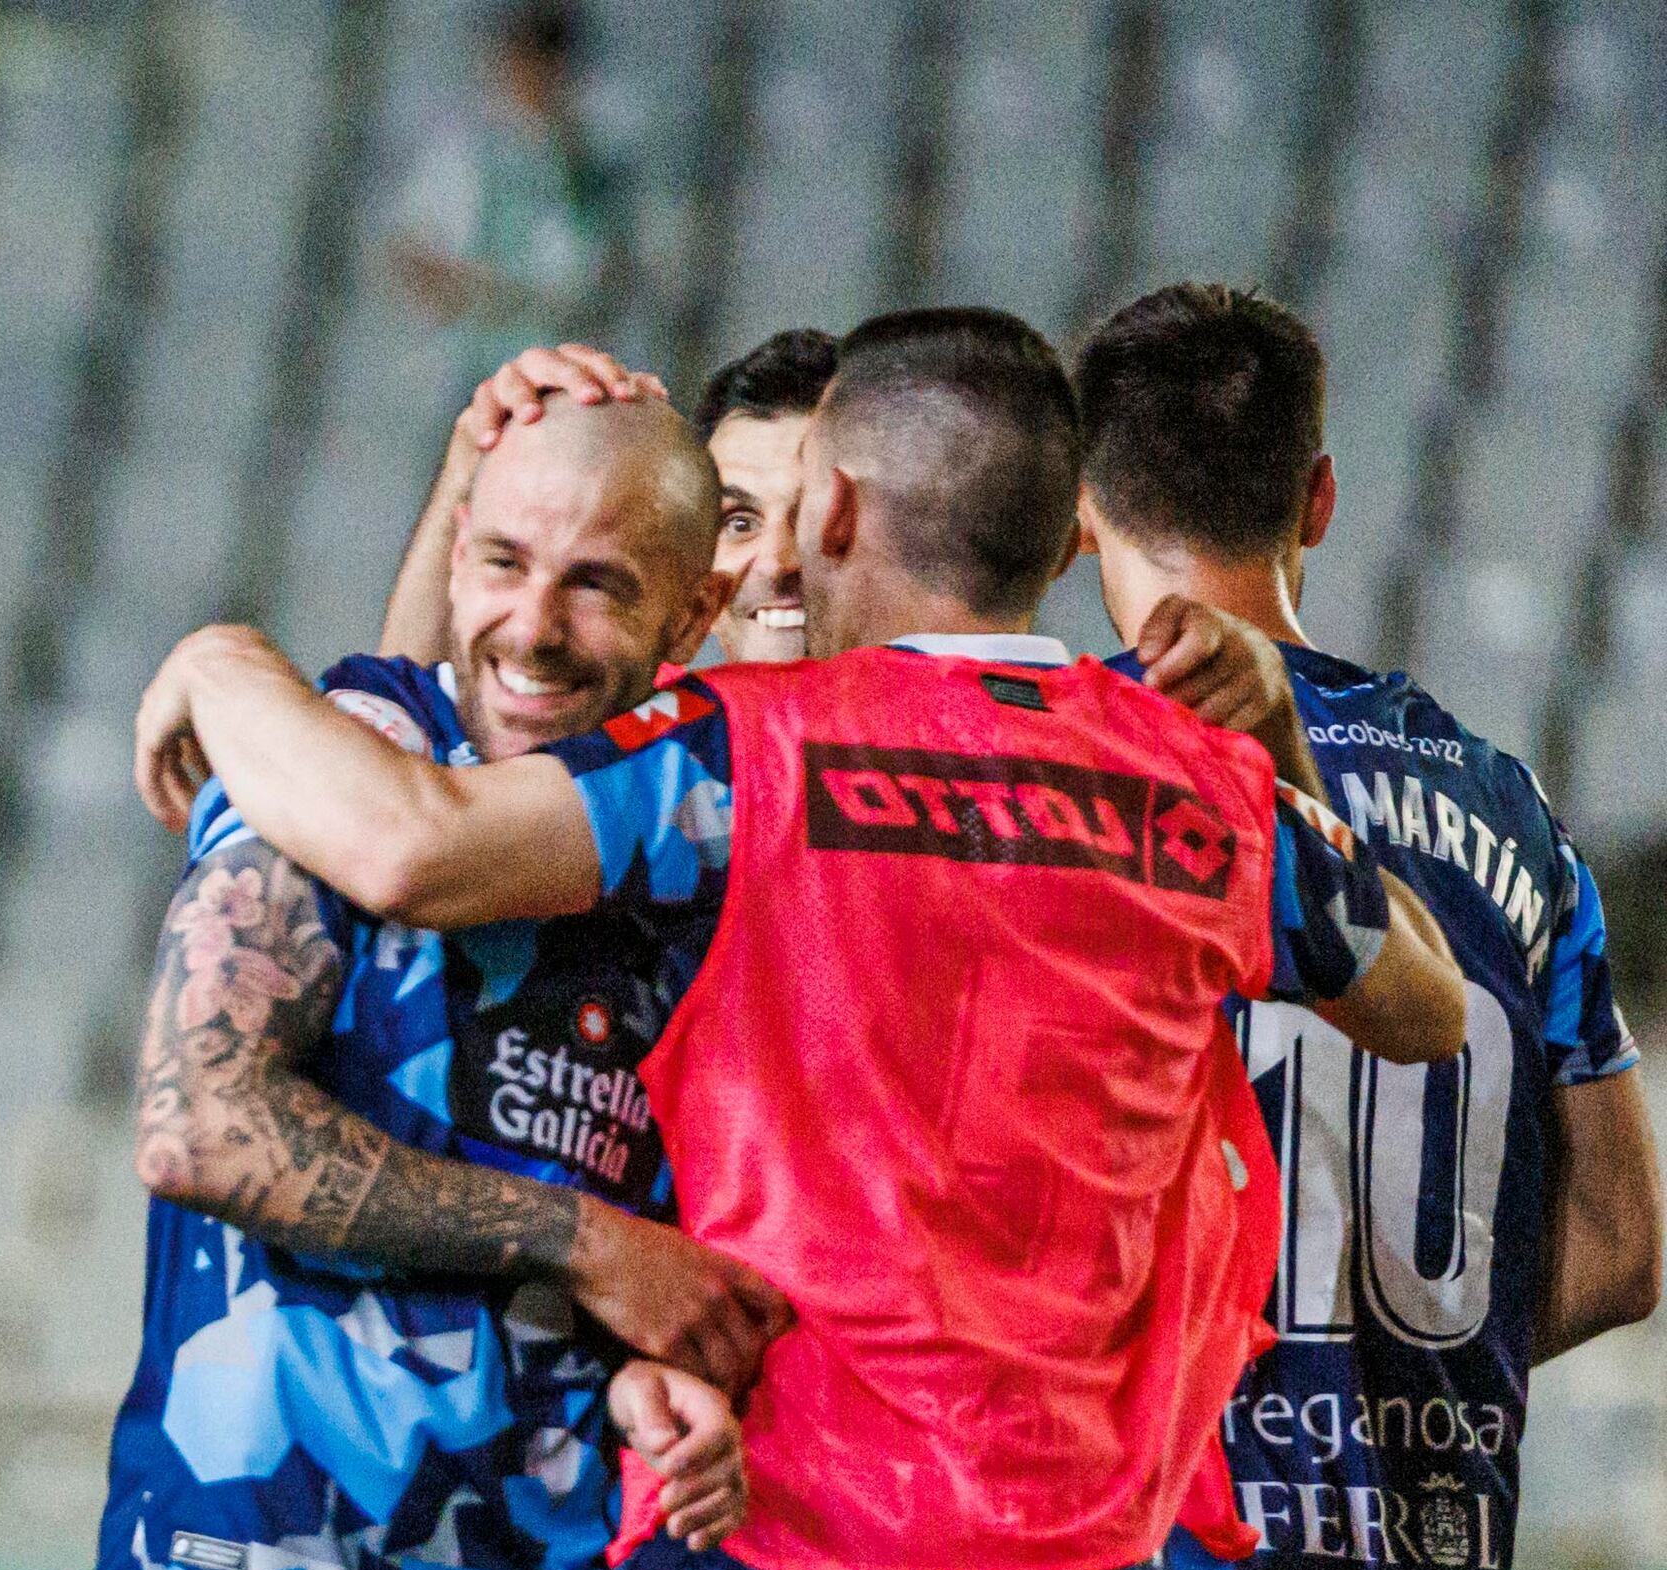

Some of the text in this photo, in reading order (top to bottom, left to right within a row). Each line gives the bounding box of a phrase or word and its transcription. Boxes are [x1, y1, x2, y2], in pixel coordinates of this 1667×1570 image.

[487, 1026, 651, 1133] Estrella
[489, 1082, 629, 1184] Galicia
[1236, 980, 1513, 1350] 10
[1223, 1392, 1504, 1464] reganosa
